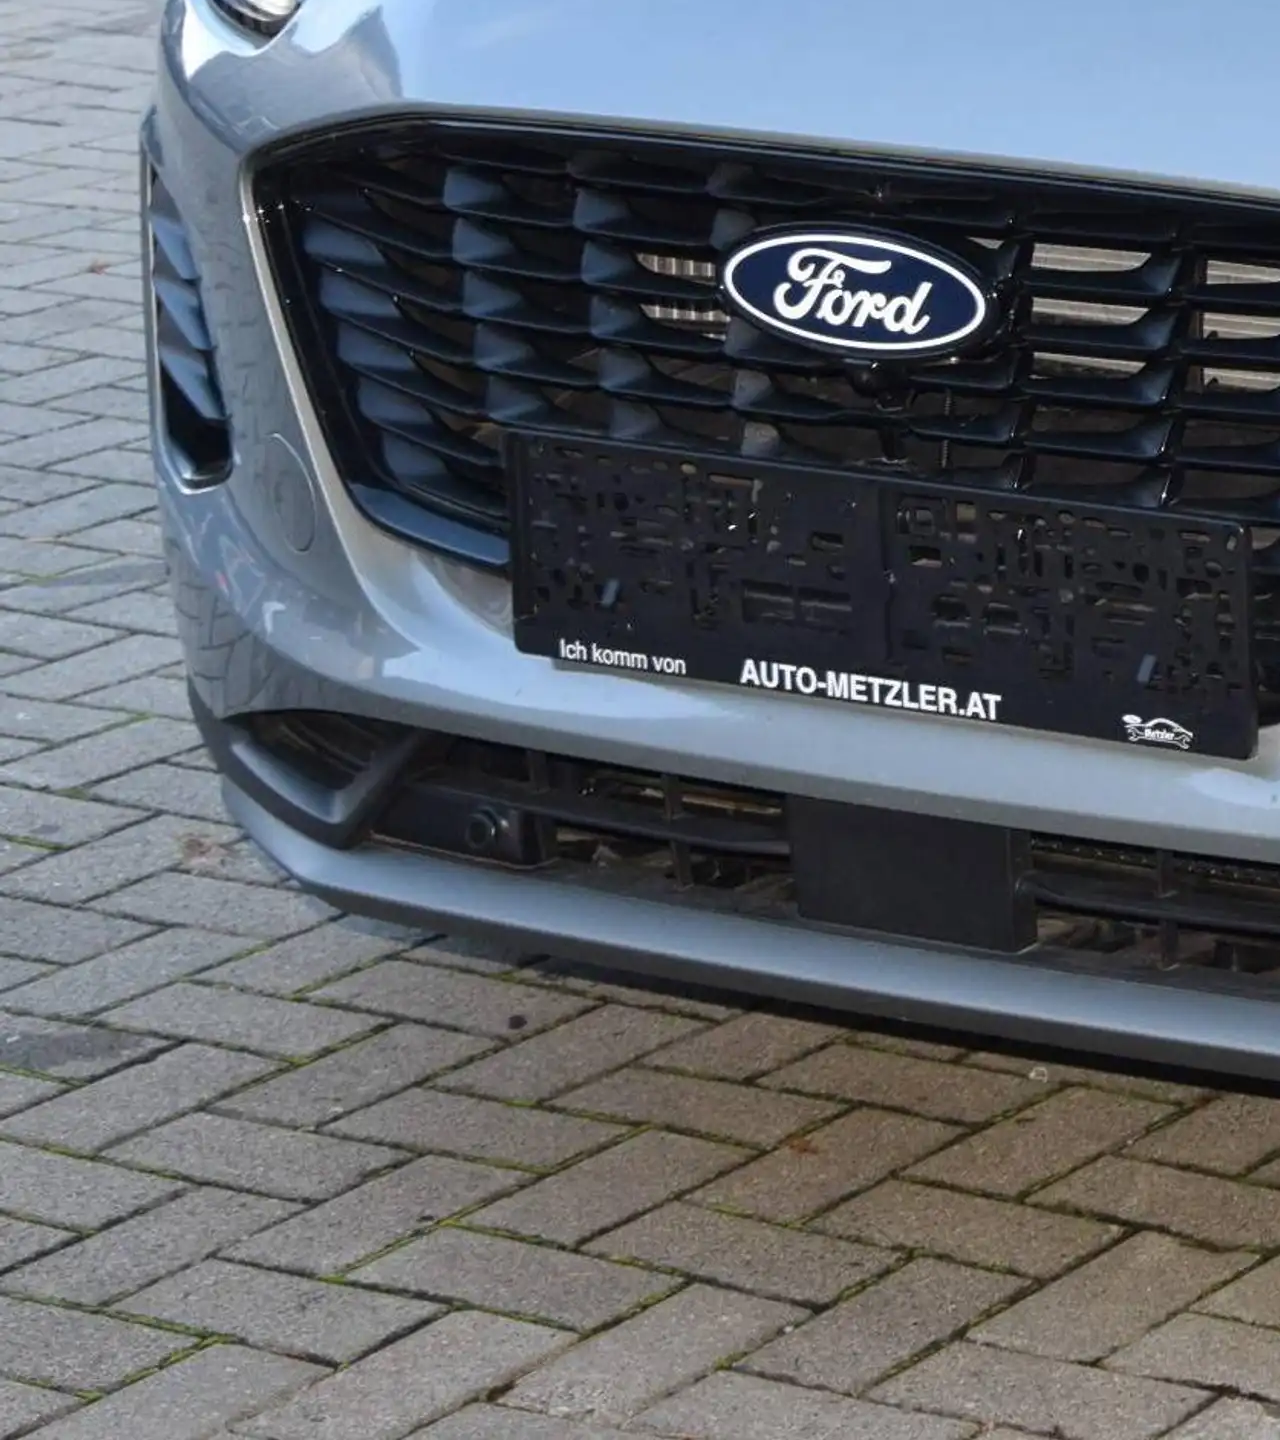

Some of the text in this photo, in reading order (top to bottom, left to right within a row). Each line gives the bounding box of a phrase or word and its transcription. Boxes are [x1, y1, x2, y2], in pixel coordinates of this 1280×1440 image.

[773, 248, 932, 335] Ford
[560, 638, 1001, 720] Ich komm von AUTO-METZLER.AT
